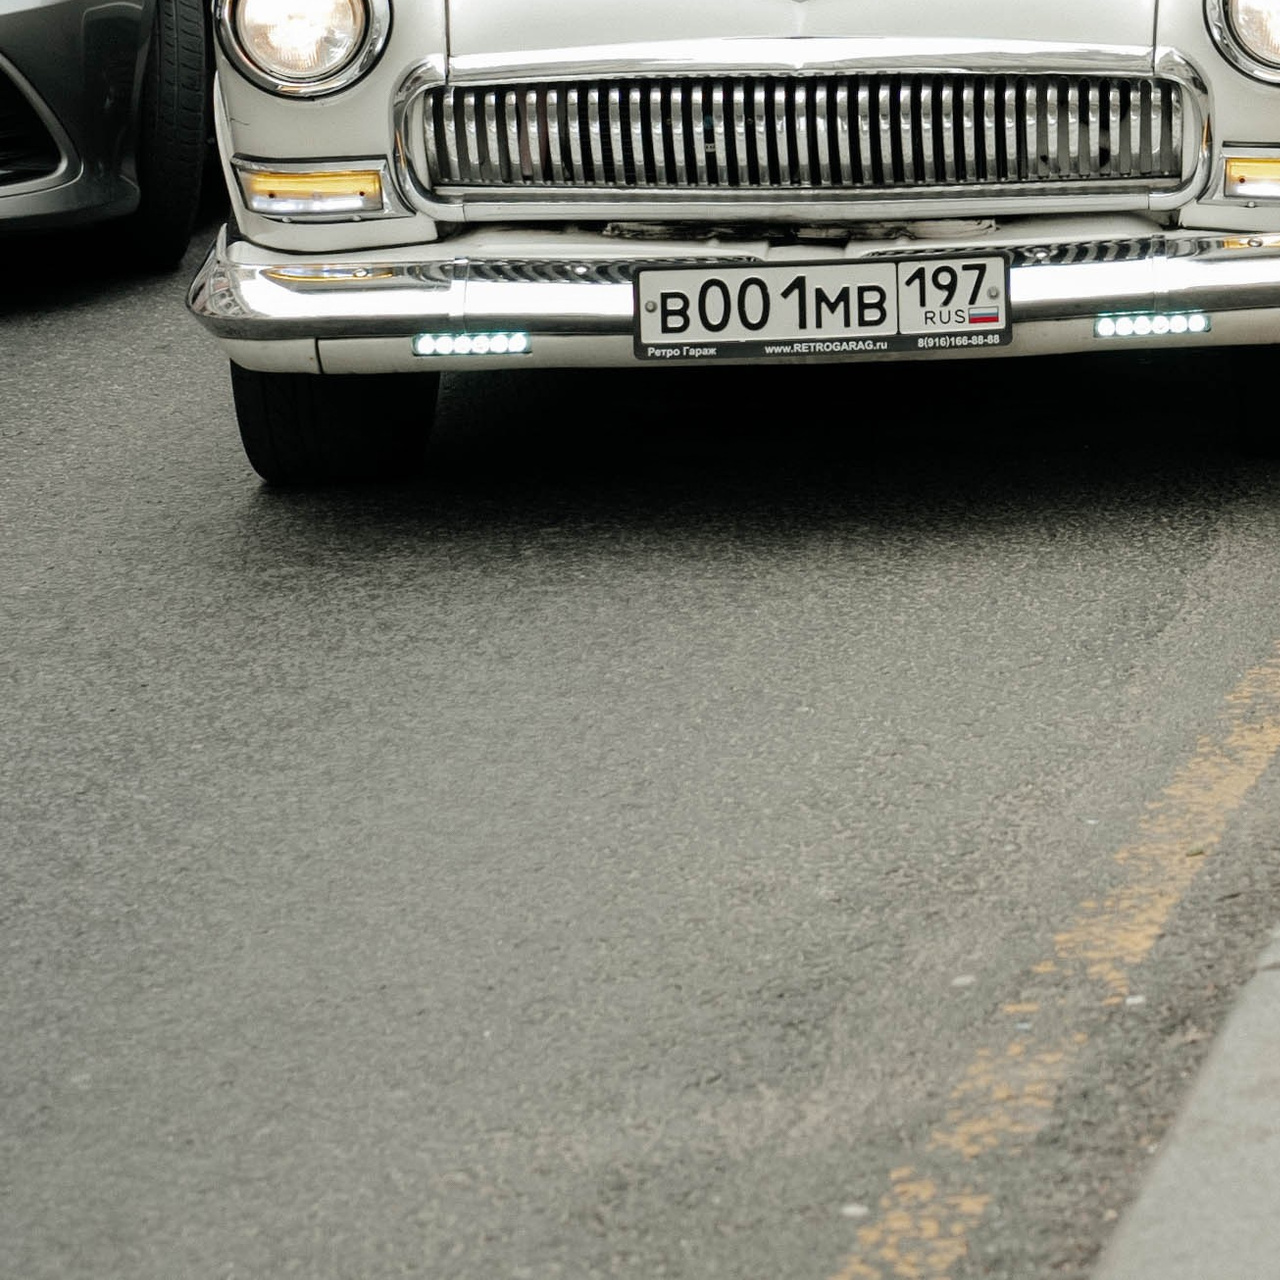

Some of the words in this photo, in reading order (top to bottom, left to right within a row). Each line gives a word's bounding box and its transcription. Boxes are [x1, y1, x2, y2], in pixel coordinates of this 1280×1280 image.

[905, 263, 987, 308] 197
[924, 309, 966, 325] RUS
[647, 347, 681, 358] Ретро
[683, 346, 717, 356] Гараж
[765, 340, 888, 354] www.RETROGARAG.ru
